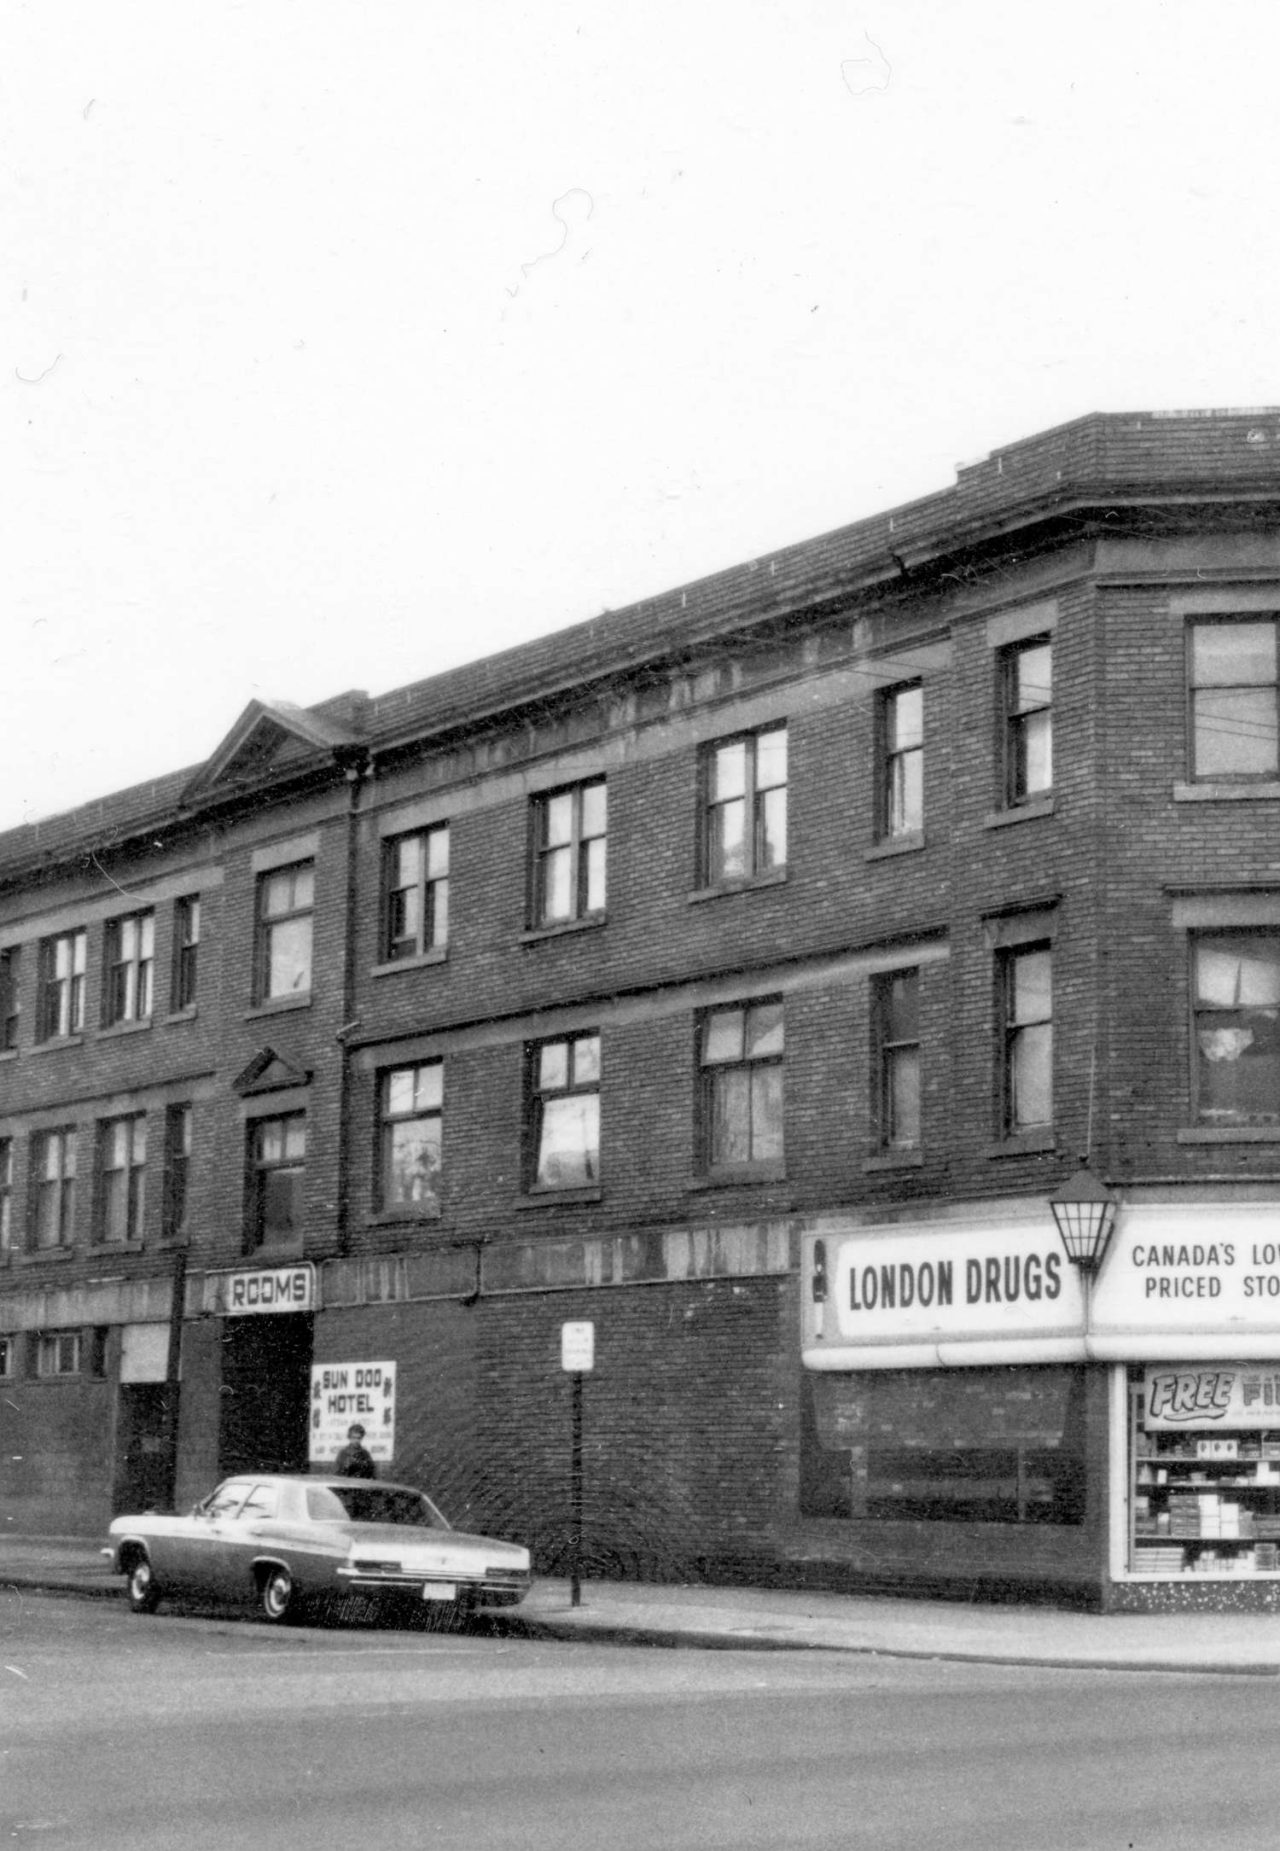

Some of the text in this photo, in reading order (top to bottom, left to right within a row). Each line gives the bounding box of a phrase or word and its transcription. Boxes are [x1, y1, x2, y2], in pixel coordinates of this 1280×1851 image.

[1132, 1243, 1235, 1267] CANADA'S
[232, 1272, 307, 1306] ROOMS
[850, 1252, 1062, 1311] LONDON DRUGS
[1145, 1276, 1222, 1298] PRICED
[323, 1370, 349, 1390] SUN
[328, 1393, 375, 1414] HOTEL
[1150, 1371, 1236, 1418] FREE
